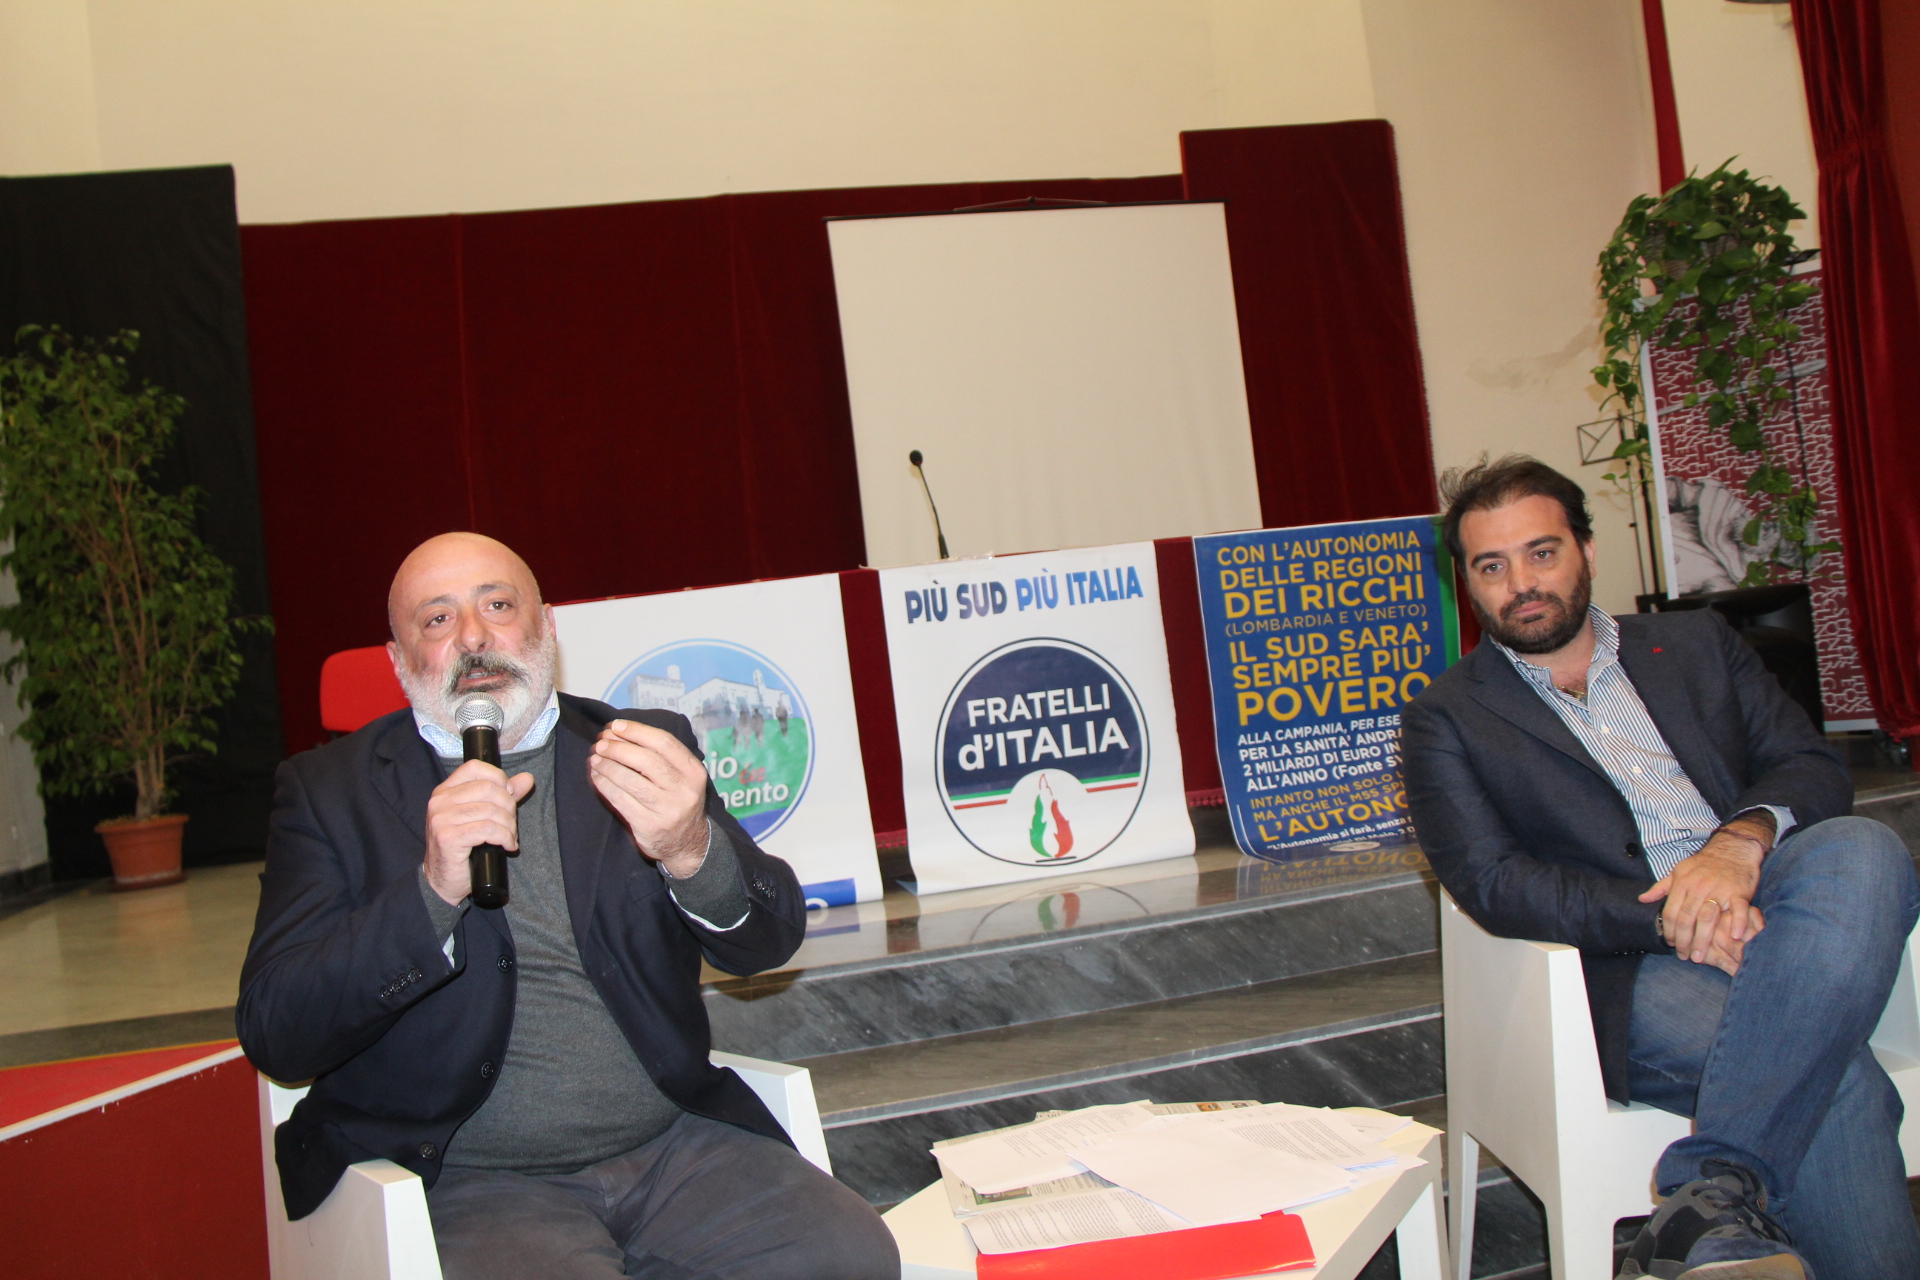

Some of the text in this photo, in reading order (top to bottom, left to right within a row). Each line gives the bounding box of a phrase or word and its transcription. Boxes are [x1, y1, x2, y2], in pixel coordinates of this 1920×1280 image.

[1217, 530, 1420, 566] CON L'AUTONOMIA
[1220, 552, 1422, 590] DELLE REGIONI
[904, 565, 1144, 624] PIÙ SUD PIÙ ITALIA
[1224, 574, 1424, 619] DEI RICCHI
[1225, 604, 1427, 637] (LOMBARDIA E VENETO)
[1230, 622, 1428, 664] IL SUD SARA'
[1232, 644, 1431, 689] SEMPRE PIU'
[967, 683, 1110, 728] FRATELLI
[1237, 671, 1432, 726] POVERO
[958, 717, 1130, 771] d'ITALIA
[1238, 732, 1272, 746] ALLA
[1275, 722, 1347, 740] CAMPANIA,
[1350, 718, 1374, 731] PER
[1239, 746, 1269, 762] PER
[1271, 744, 1292, 758] LA
[1295, 735, 1352, 754] SANITA'
[702, 750, 738, 780] io
[1242, 764, 1253, 776] 2
[1256, 755, 1320, 775] MILIARDI
[1322, 753, 1339, 764] DI
[1342, 746, 1382, 762] EURO
[1246, 768, 1328, 792] ALL'ANNO
[1332, 762, 1383, 779] (Fonte
[1250, 790, 1314, 809] INTANTO
[1317, 783, 1351, 798] NON
[1353, 773, 1393, 790] SOLO
[1253, 810, 1276, 822] MA
[1280, 800, 1330, 818] ANCHE
[1333, 797, 1347, 807] IL
